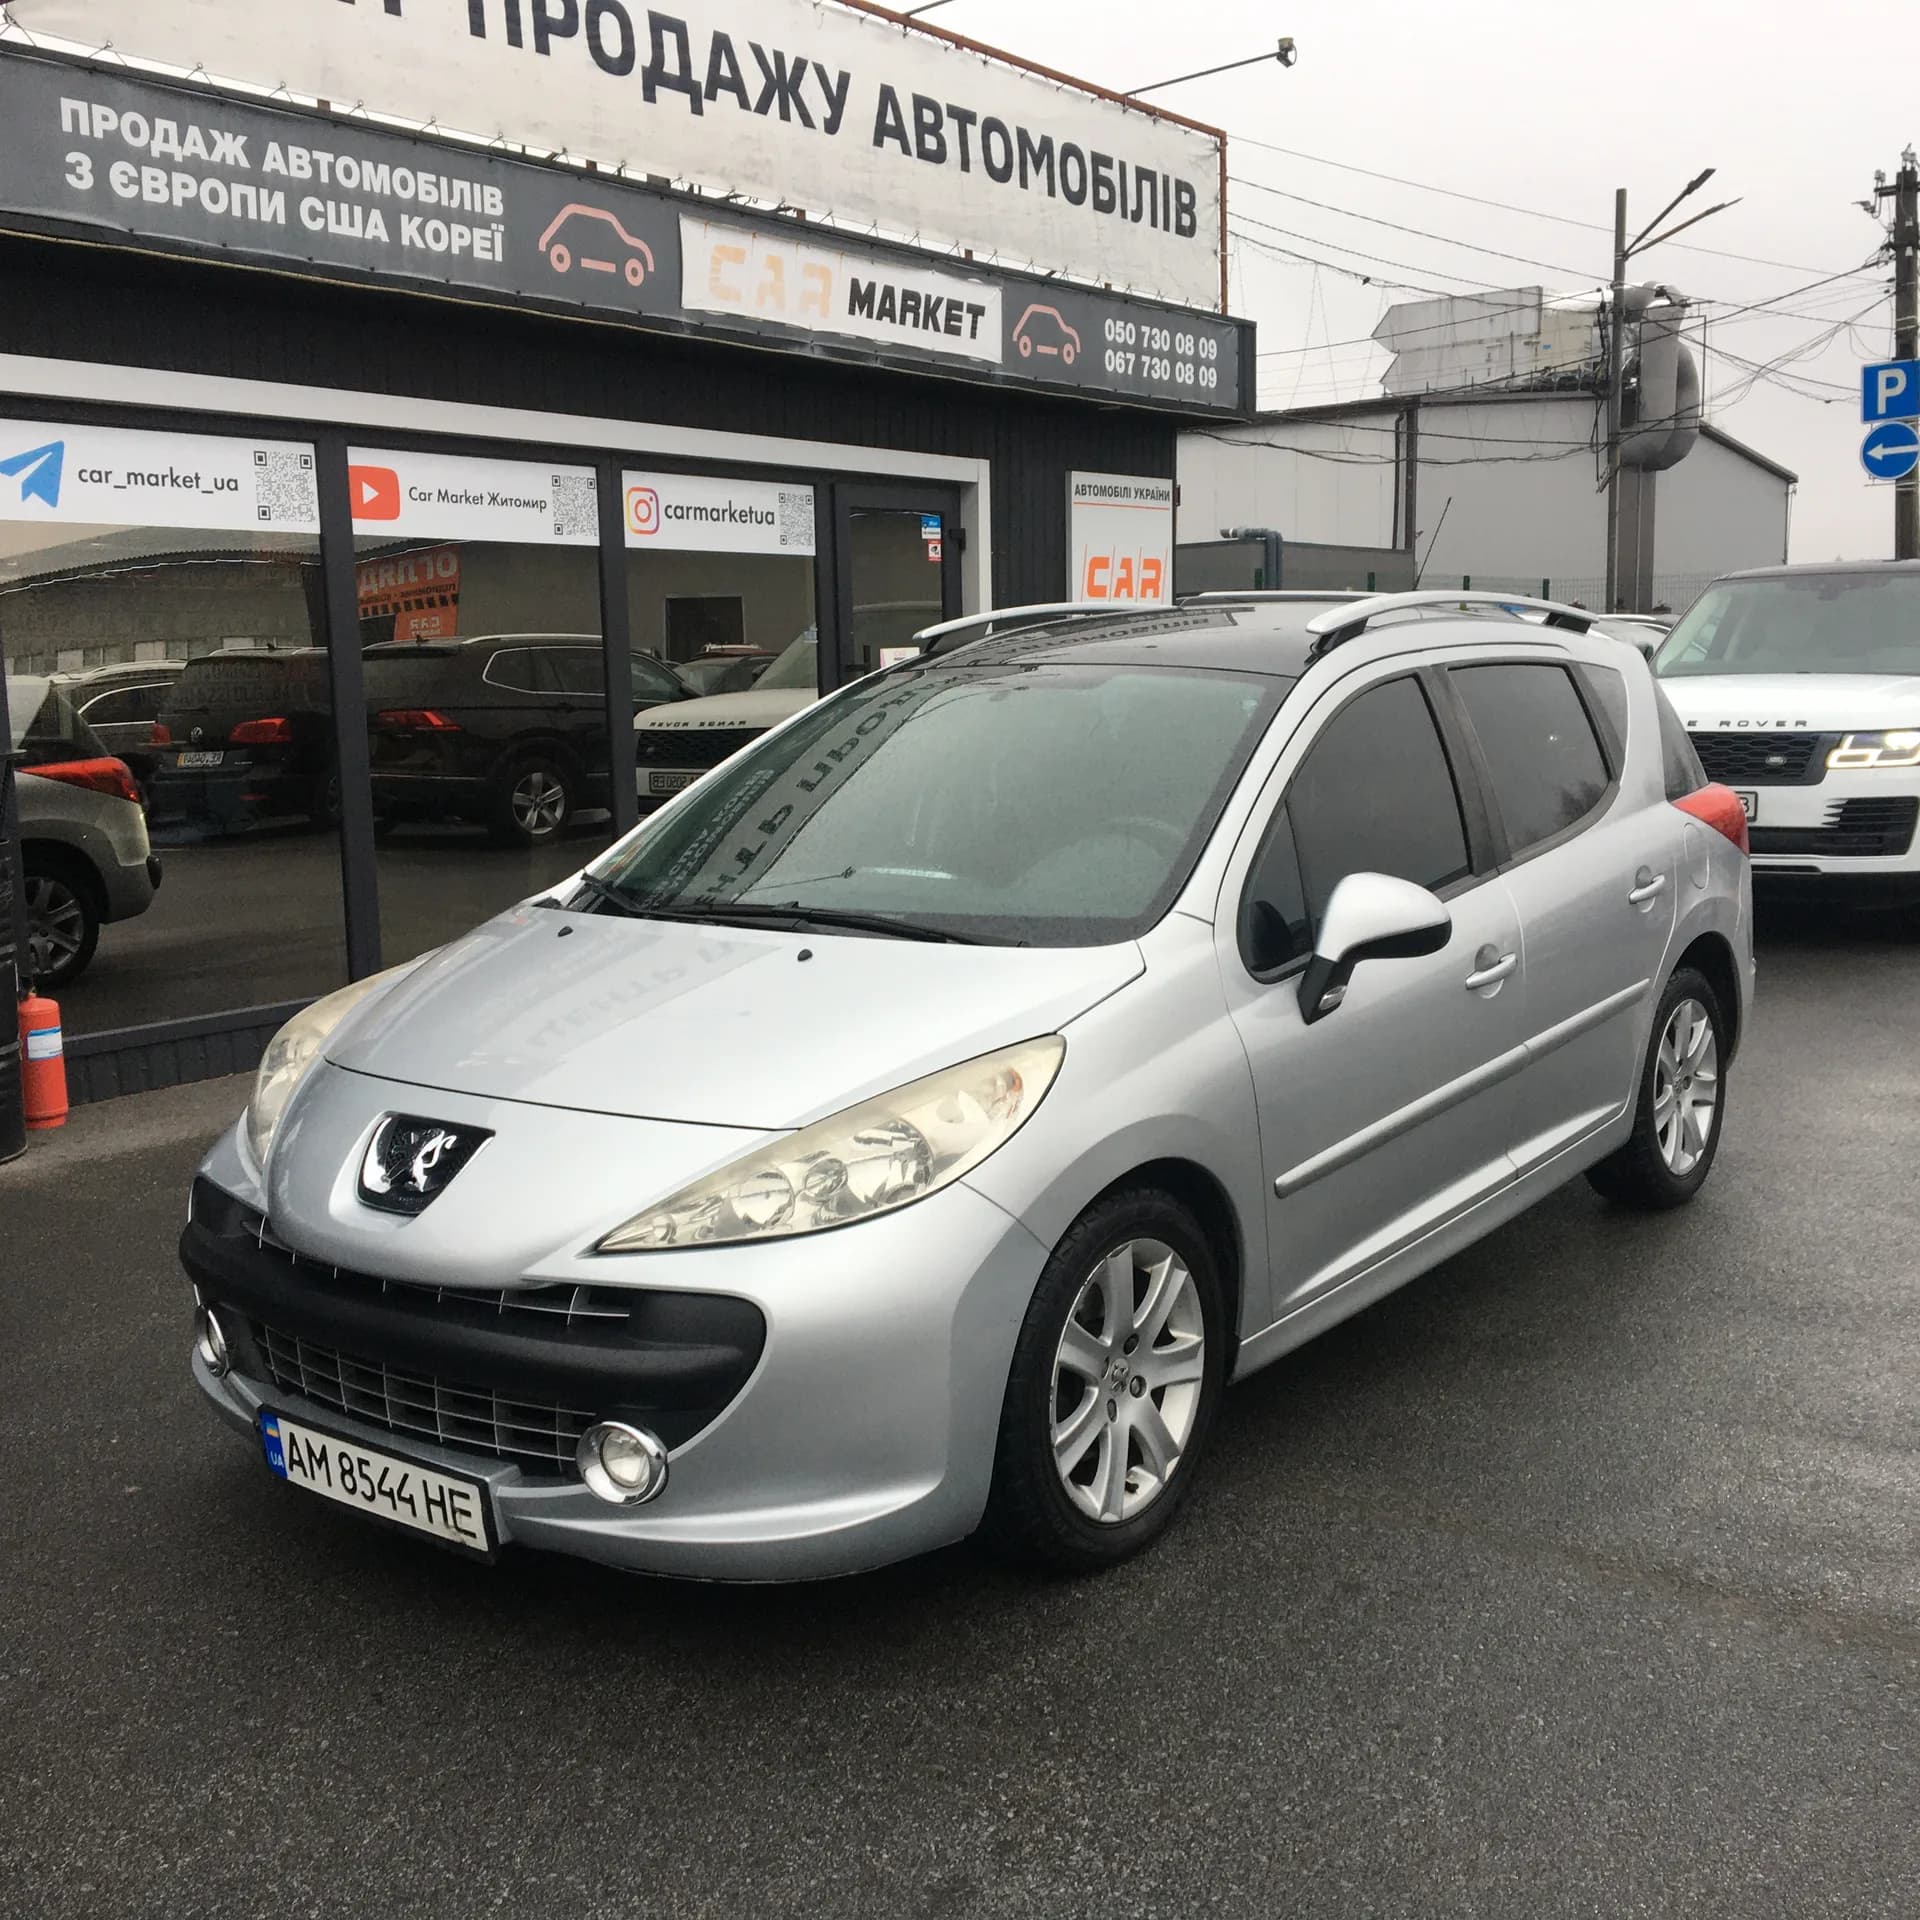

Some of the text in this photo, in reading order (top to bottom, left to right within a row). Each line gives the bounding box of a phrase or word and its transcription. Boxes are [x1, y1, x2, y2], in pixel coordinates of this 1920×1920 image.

[60, 97, 504, 217] ПРОДАЖ АВТОМОБІЛІВ
[872, 83, 1198, 239] АВТОМОБІЛІВ
[64, 151, 504, 262] З ЄВРОПИ США КОРЕЇ
[709, 245, 986, 339] CAR MARKET
[1105, 318, 1217, 360] 050 730 08 09
[1105, 348, 1217, 388] 067 730 08 09
[1877, 368, 1907, 415] P
[78, 466, 239, 494] car_market_ua
[408, 486, 547, 513] Car Market Житомир
[1074, 484, 1170, 502] АВТОМОБІЛІ УКРАЇНИ
[664, 500, 775, 526] carmarketua
[1087, 556, 1162, 599] CAR
[1719, 720, 1808, 728] ROVER
[270, 1451, 285, 1467] UA
[288, 1431, 477, 1539] AM 8544 HE
